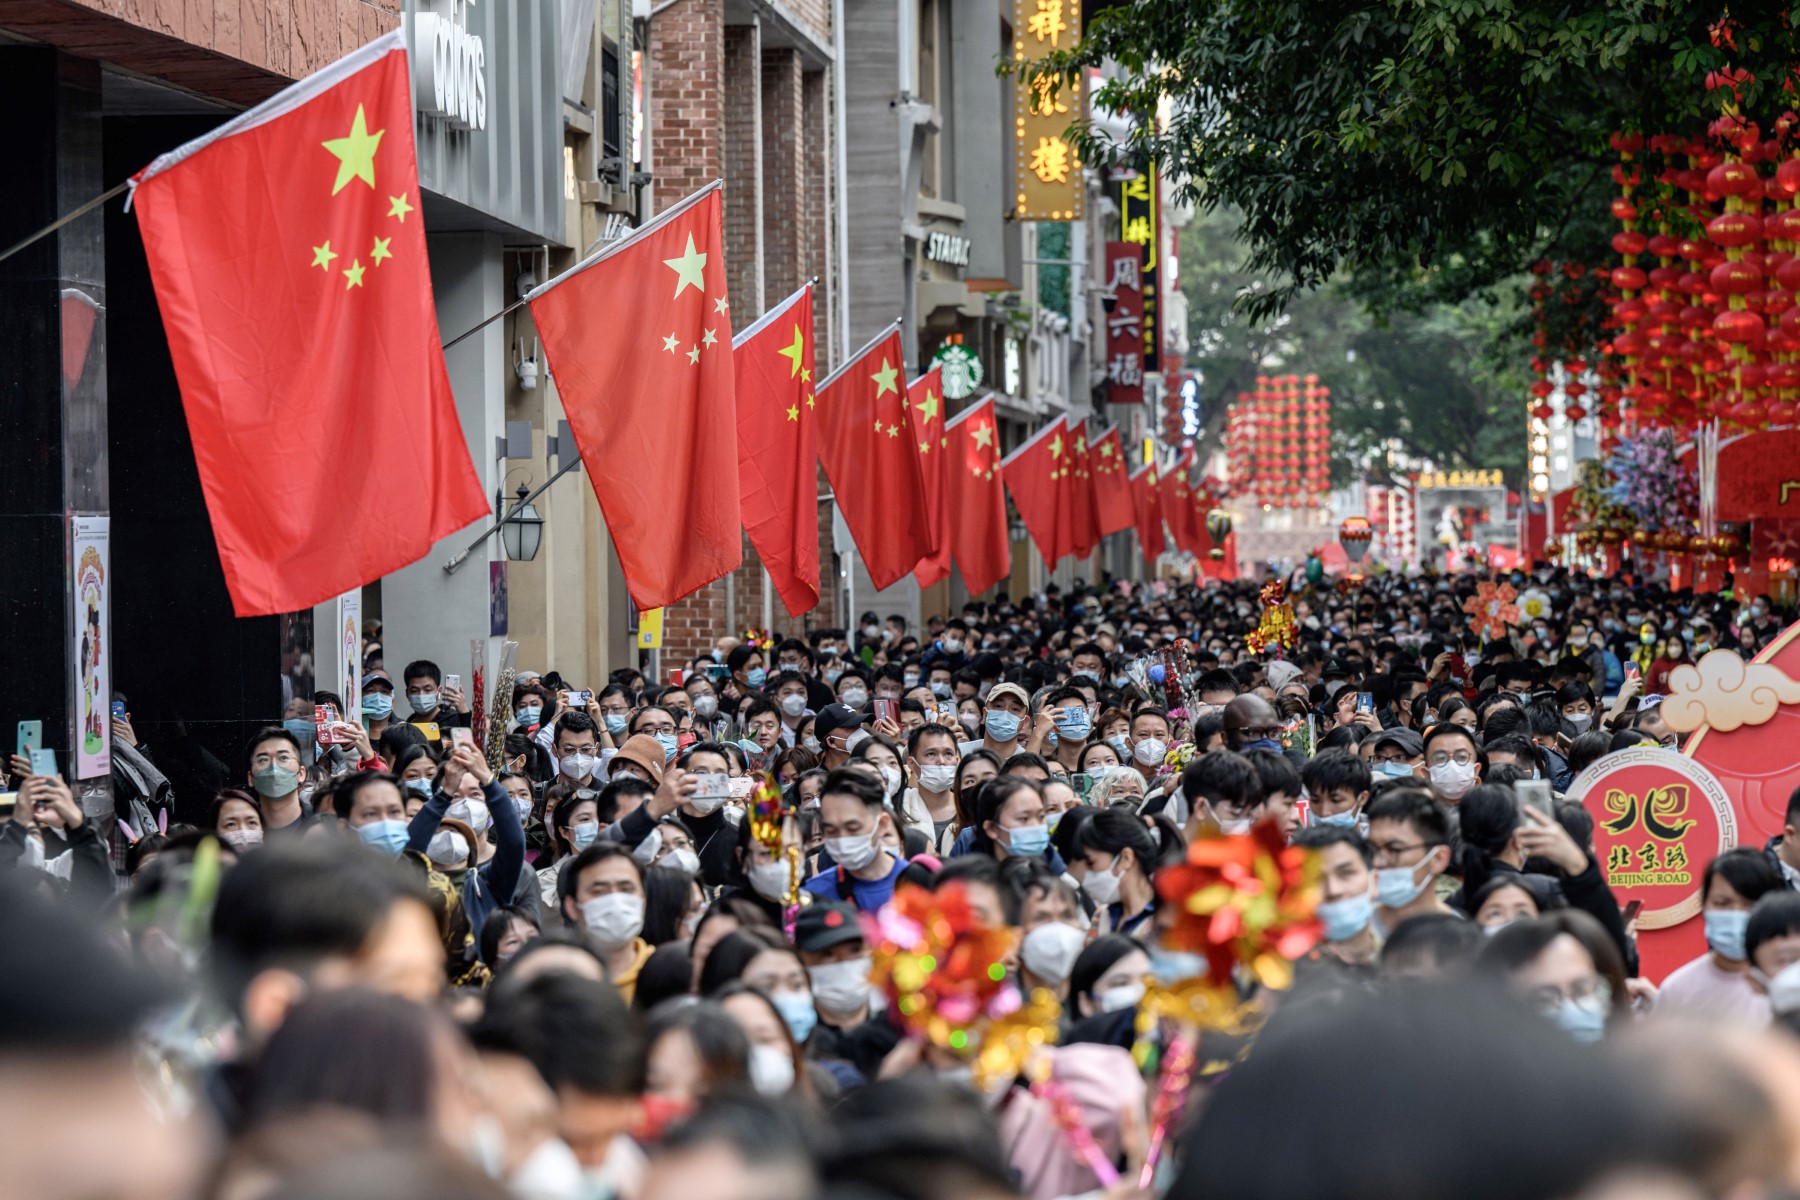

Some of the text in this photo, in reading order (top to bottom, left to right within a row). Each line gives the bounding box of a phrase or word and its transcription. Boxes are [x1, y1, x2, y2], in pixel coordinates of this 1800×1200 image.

[1103, 256, 1142, 387] 周六福
[1608, 843, 1687, 871] 北京路
[1609, 873, 1690, 887] BEIJING ROAD
